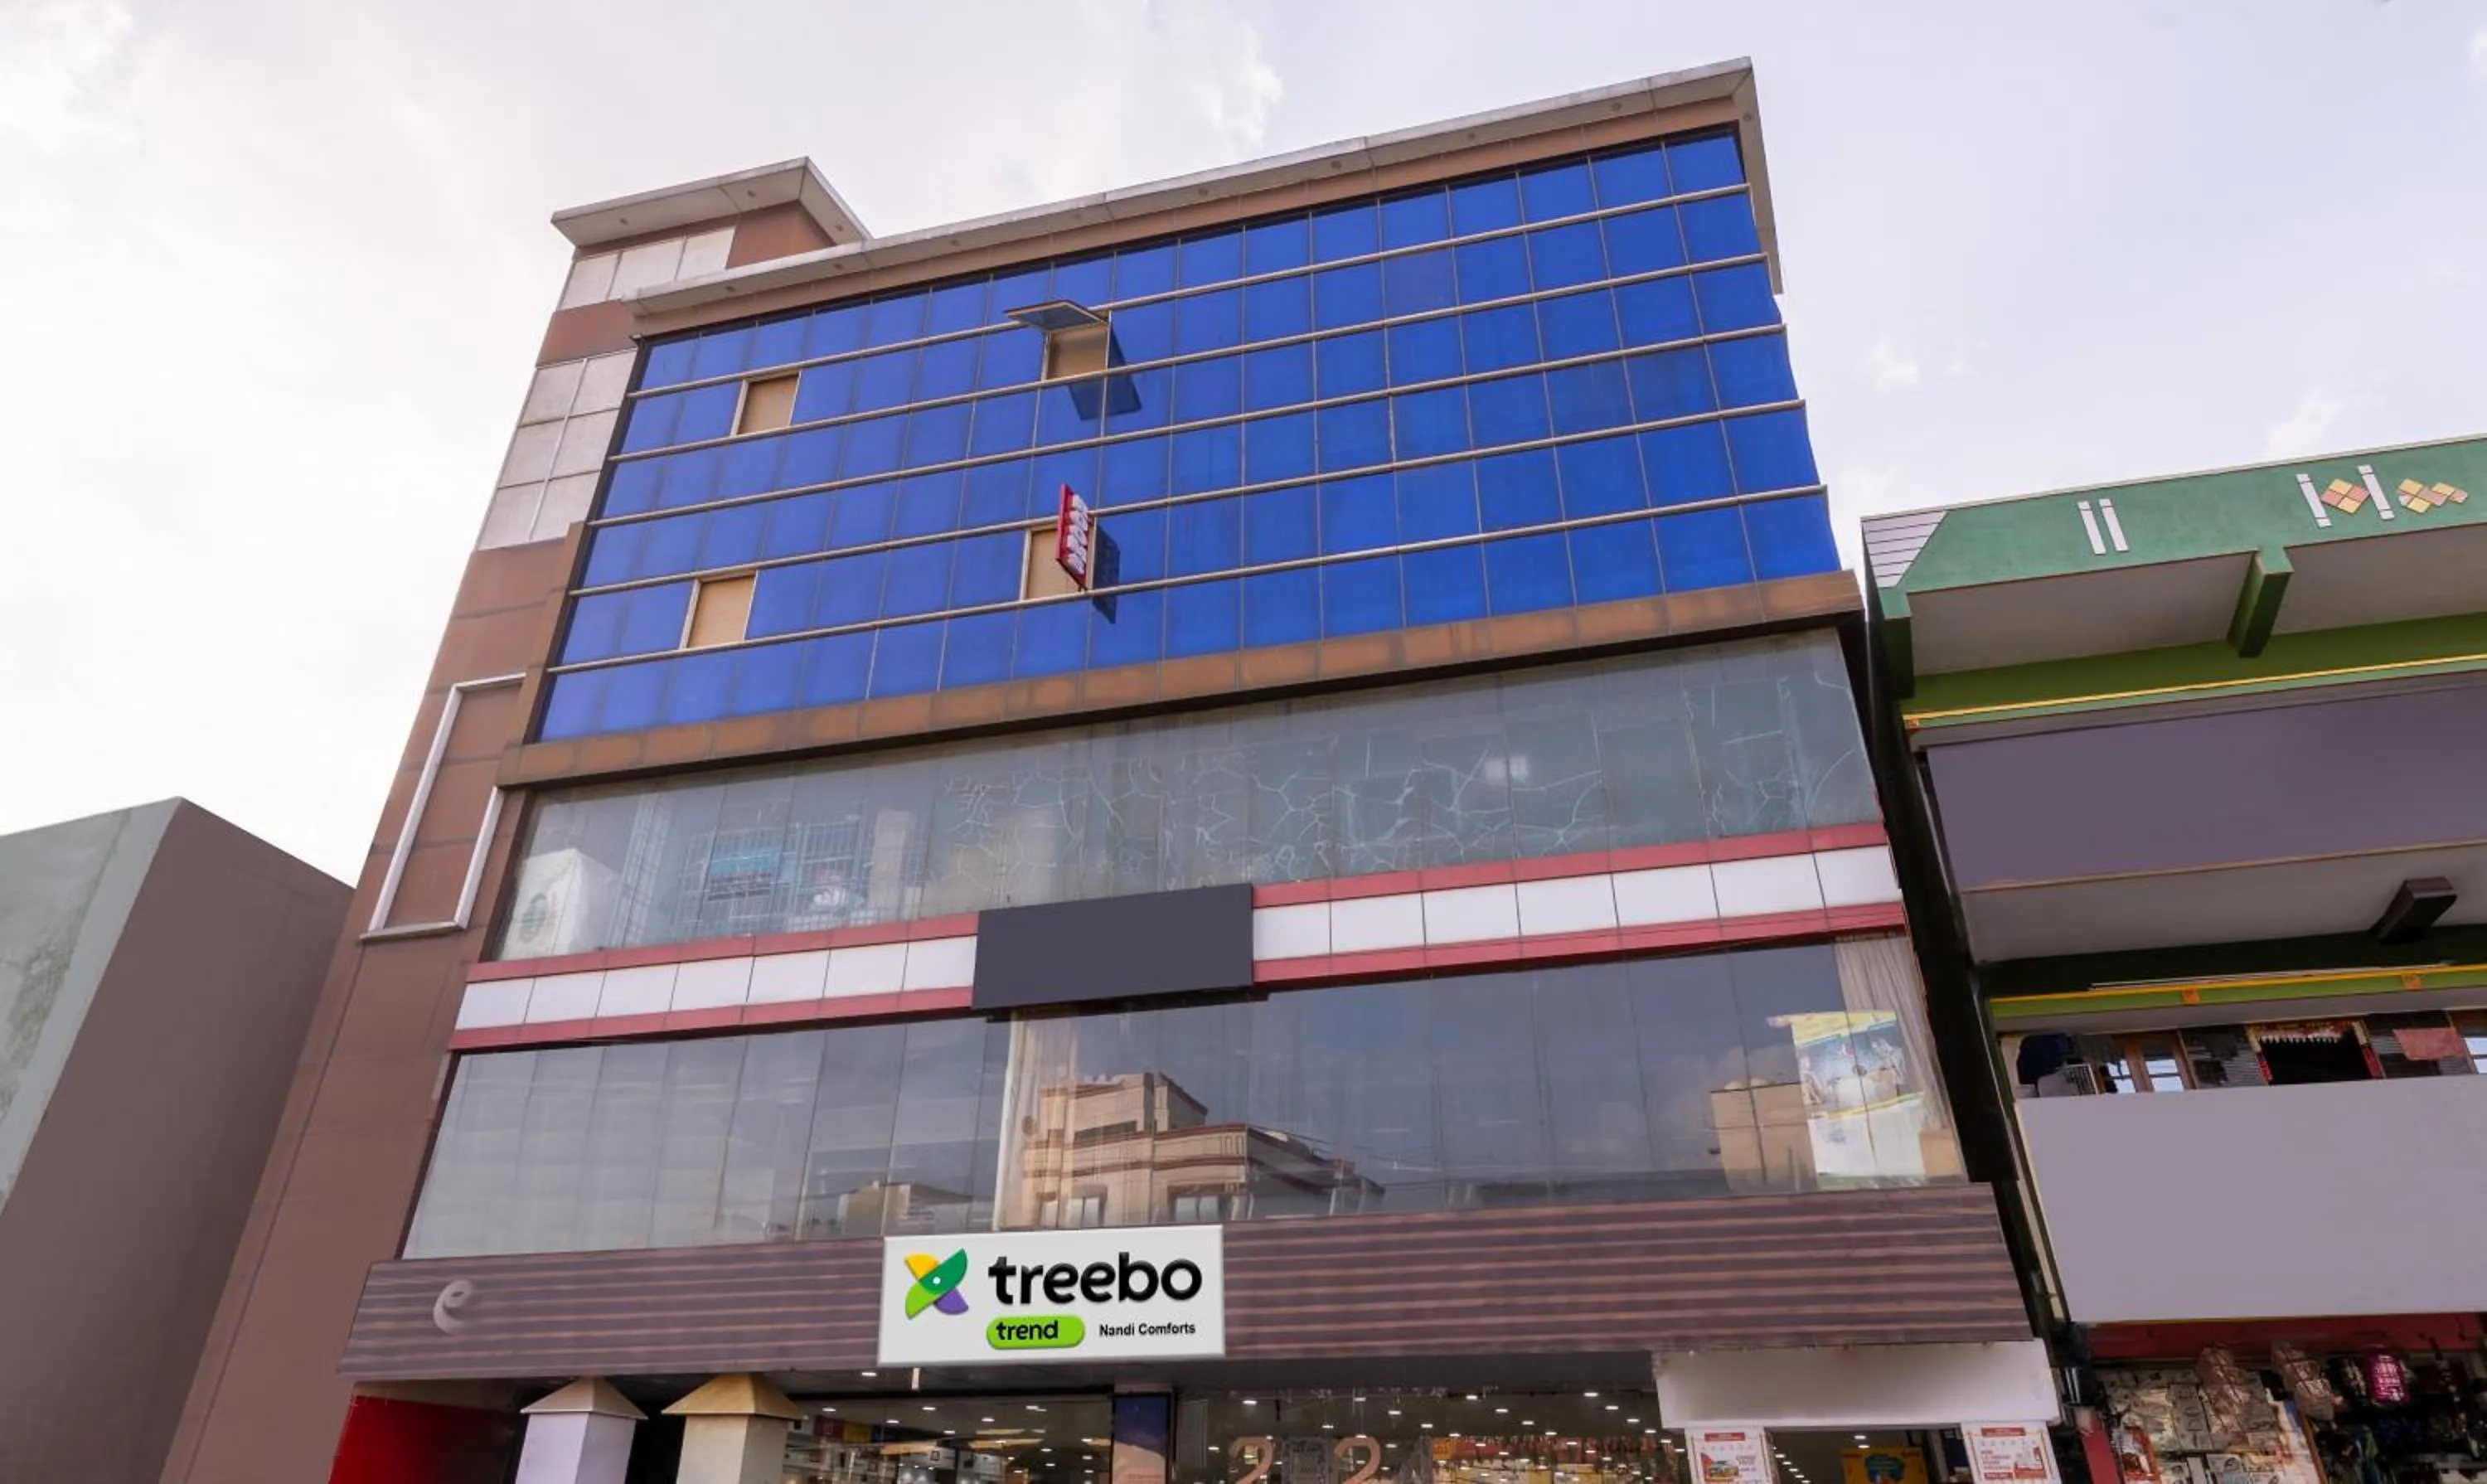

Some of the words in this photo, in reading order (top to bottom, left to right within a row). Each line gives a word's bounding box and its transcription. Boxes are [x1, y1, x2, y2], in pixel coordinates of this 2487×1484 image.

[988, 1251, 1202, 1305] treebo
[996, 1320, 1058, 1341] trend
[1099, 1323, 1135, 1337] Nandi
[1138, 1322, 1196, 1336] Comforts
